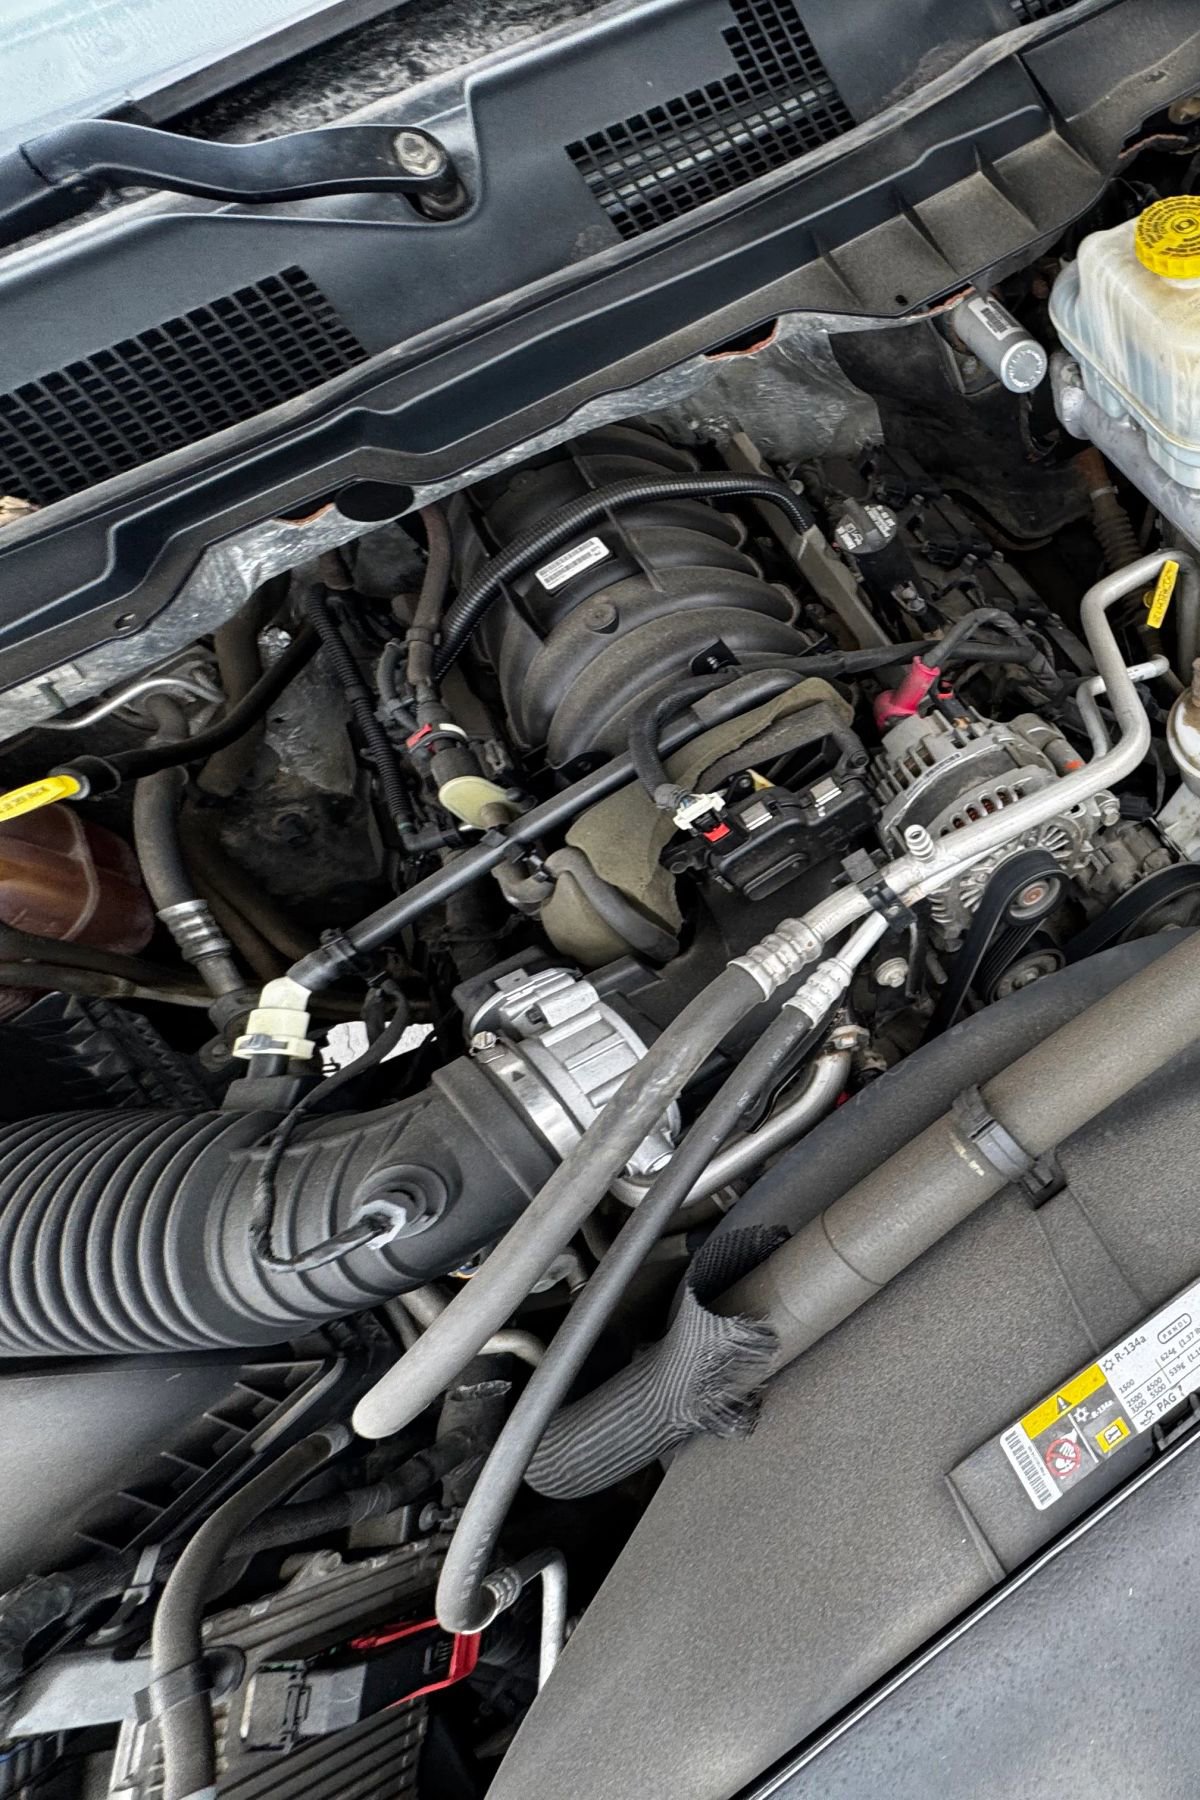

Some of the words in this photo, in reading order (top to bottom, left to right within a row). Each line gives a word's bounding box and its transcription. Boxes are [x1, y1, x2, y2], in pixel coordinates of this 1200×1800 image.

[1114, 1336, 1146, 1362] R-134a
[1160, 1348, 1177, 1361] 624g
[1169, 1362, 1186, 1376] 539g
[1119, 1379, 1135, 1393] 1500
[1146, 1377, 1162, 1392] 4500
[1149, 1383, 1166, 1398] 5500
[1156, 1392, 1177, 1412] PAG
